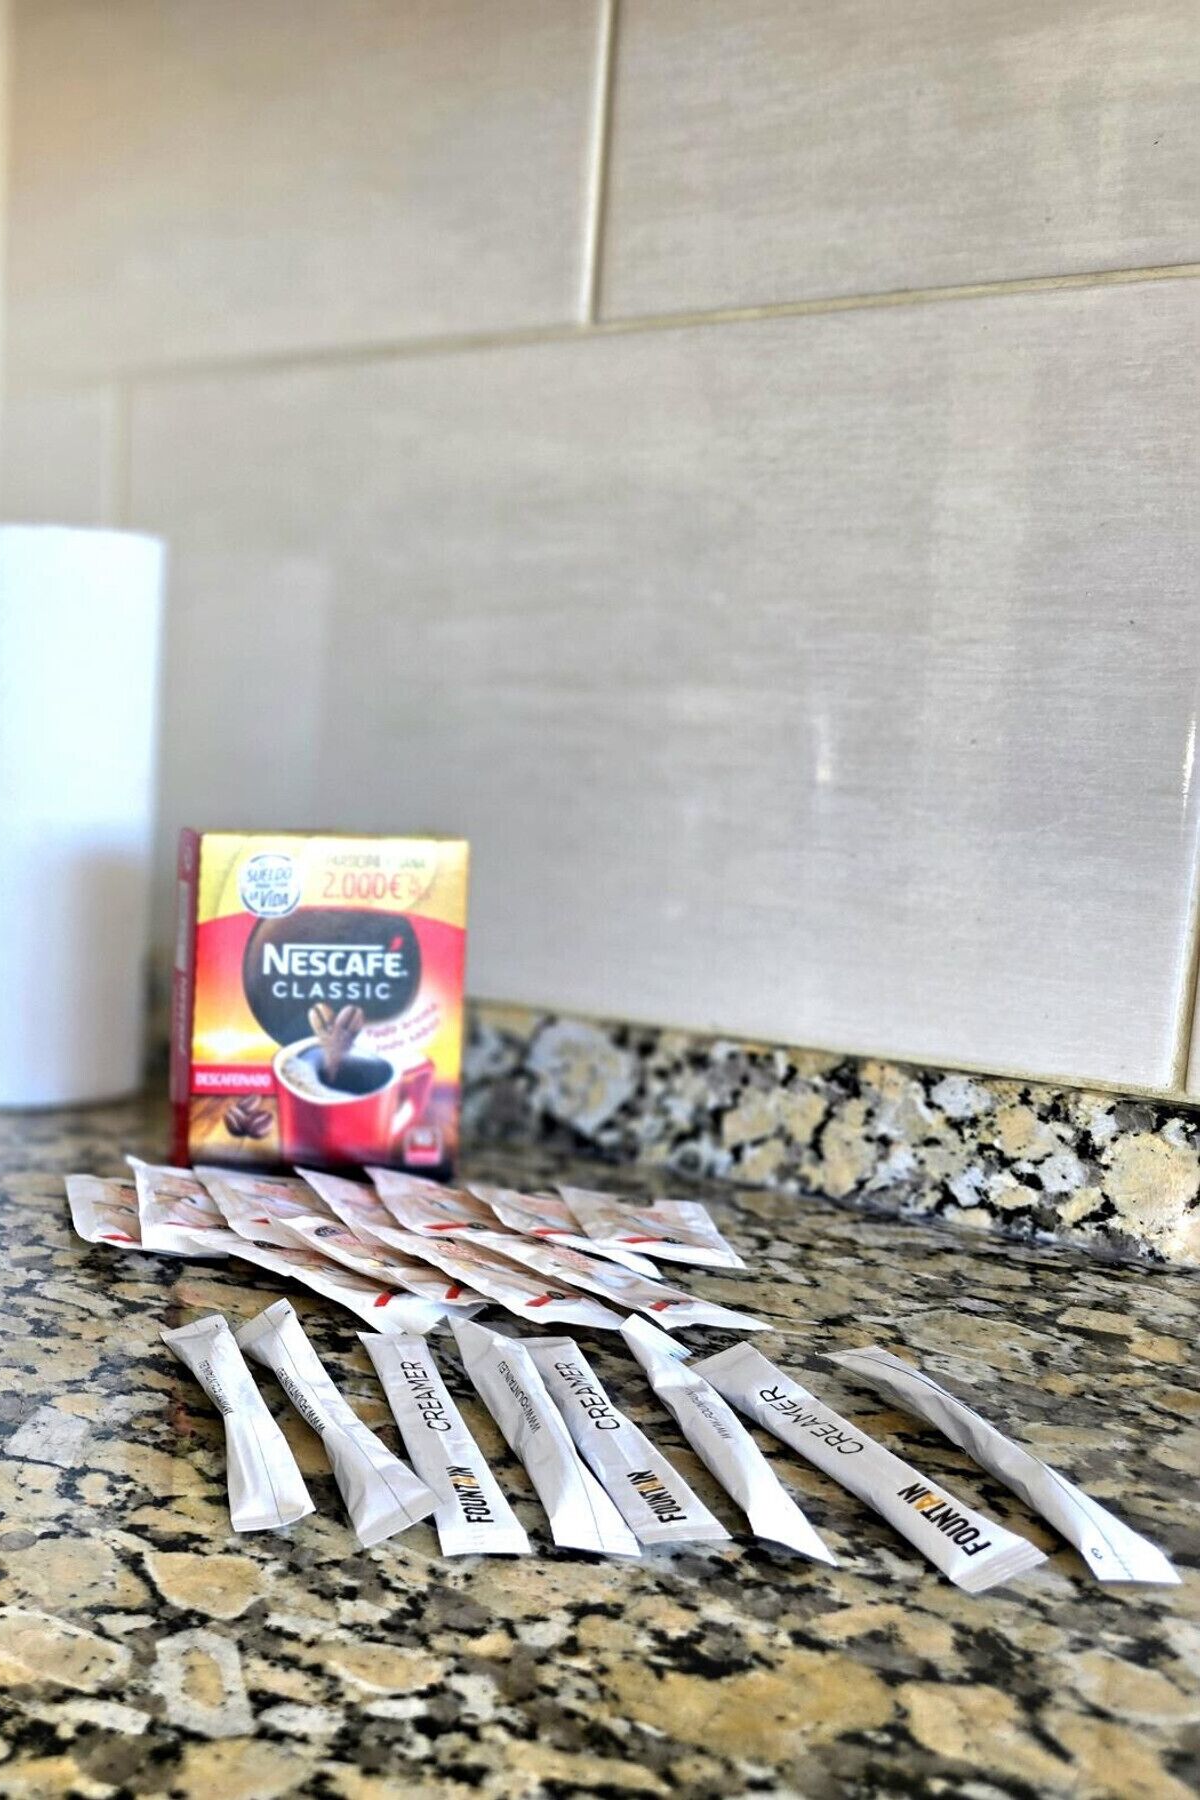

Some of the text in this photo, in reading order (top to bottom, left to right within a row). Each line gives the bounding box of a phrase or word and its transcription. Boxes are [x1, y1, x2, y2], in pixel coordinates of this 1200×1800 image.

[263, 936, 407, 977] NESCAFÉ
[272, 981, 392, 1000] CLASSIC
[402, 1361, 451, 1432] CREAMER
[553, 1361, 620, 1431] CREAMER
[756, 1384, 864, 1455] CREAMER
[895, 1481, 996, 1556] FOUNTAIN
